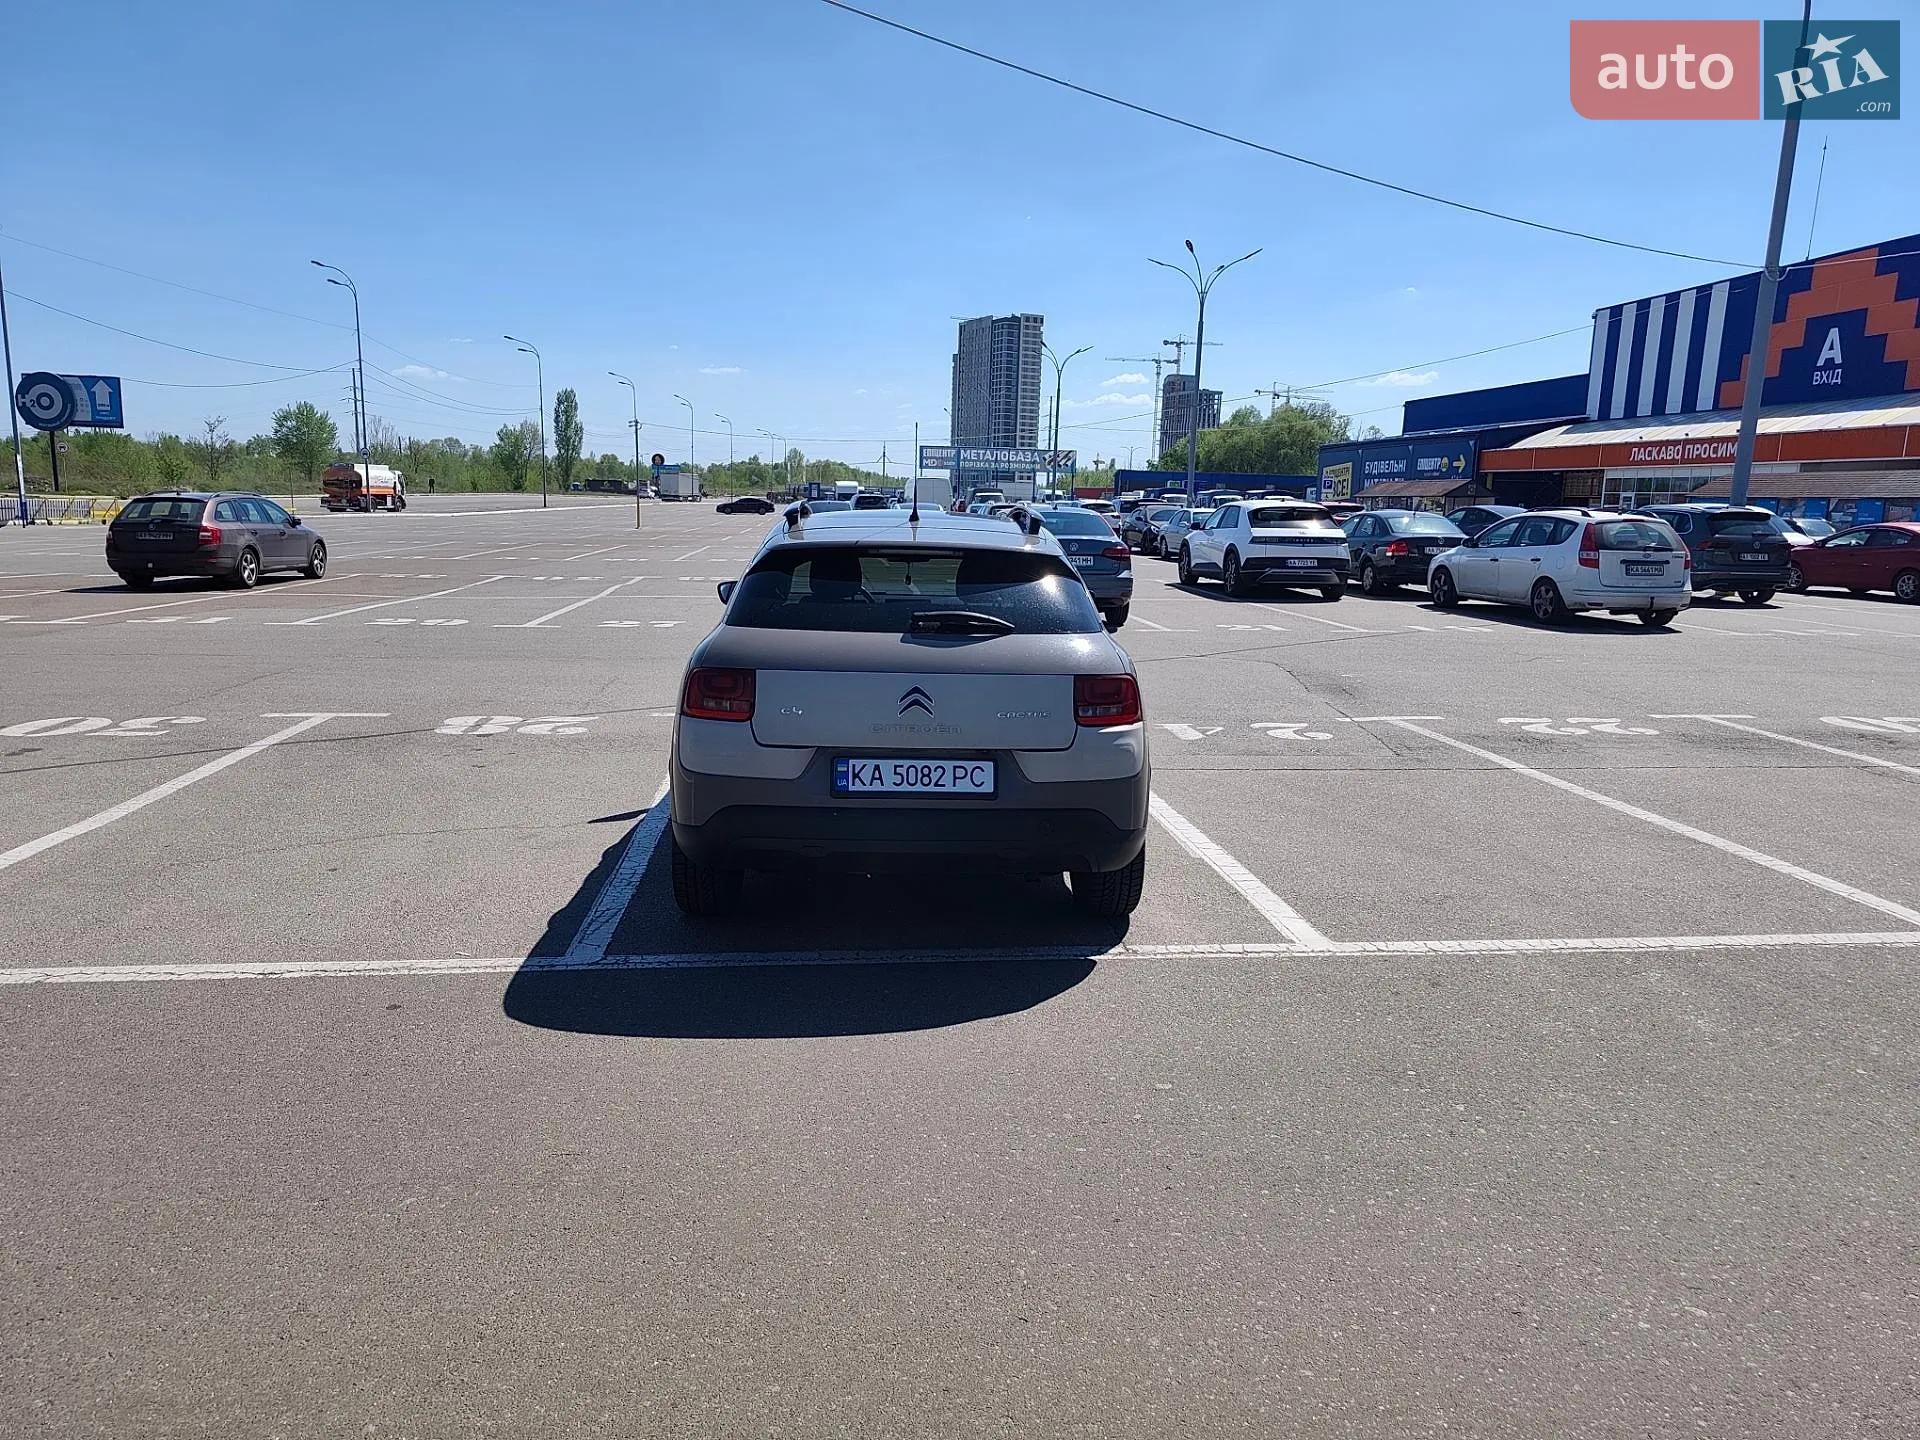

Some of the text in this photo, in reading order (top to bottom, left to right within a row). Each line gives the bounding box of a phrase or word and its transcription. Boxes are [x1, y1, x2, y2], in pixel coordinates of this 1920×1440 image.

[1816, 327, 1843, 367] А
[1812, 368, 1843, 385] ВХІД
[960, 449, 1040, 462] МЕТАЛОБАЗА
[1630, 441, 1739, 462] ЛАСКАВО ПРОСИМ
[959, 461, 989, 469] ПОРІЗКА
[1364, 459, 1407, 475] БУДІВЕЛЬНІ
[434, 715, 599, 736] 28
[1498, 717, 1660, 736] 22
[837, 778, 848, 786] UA
[851, 763, 986, 789] KA 5082 PC
